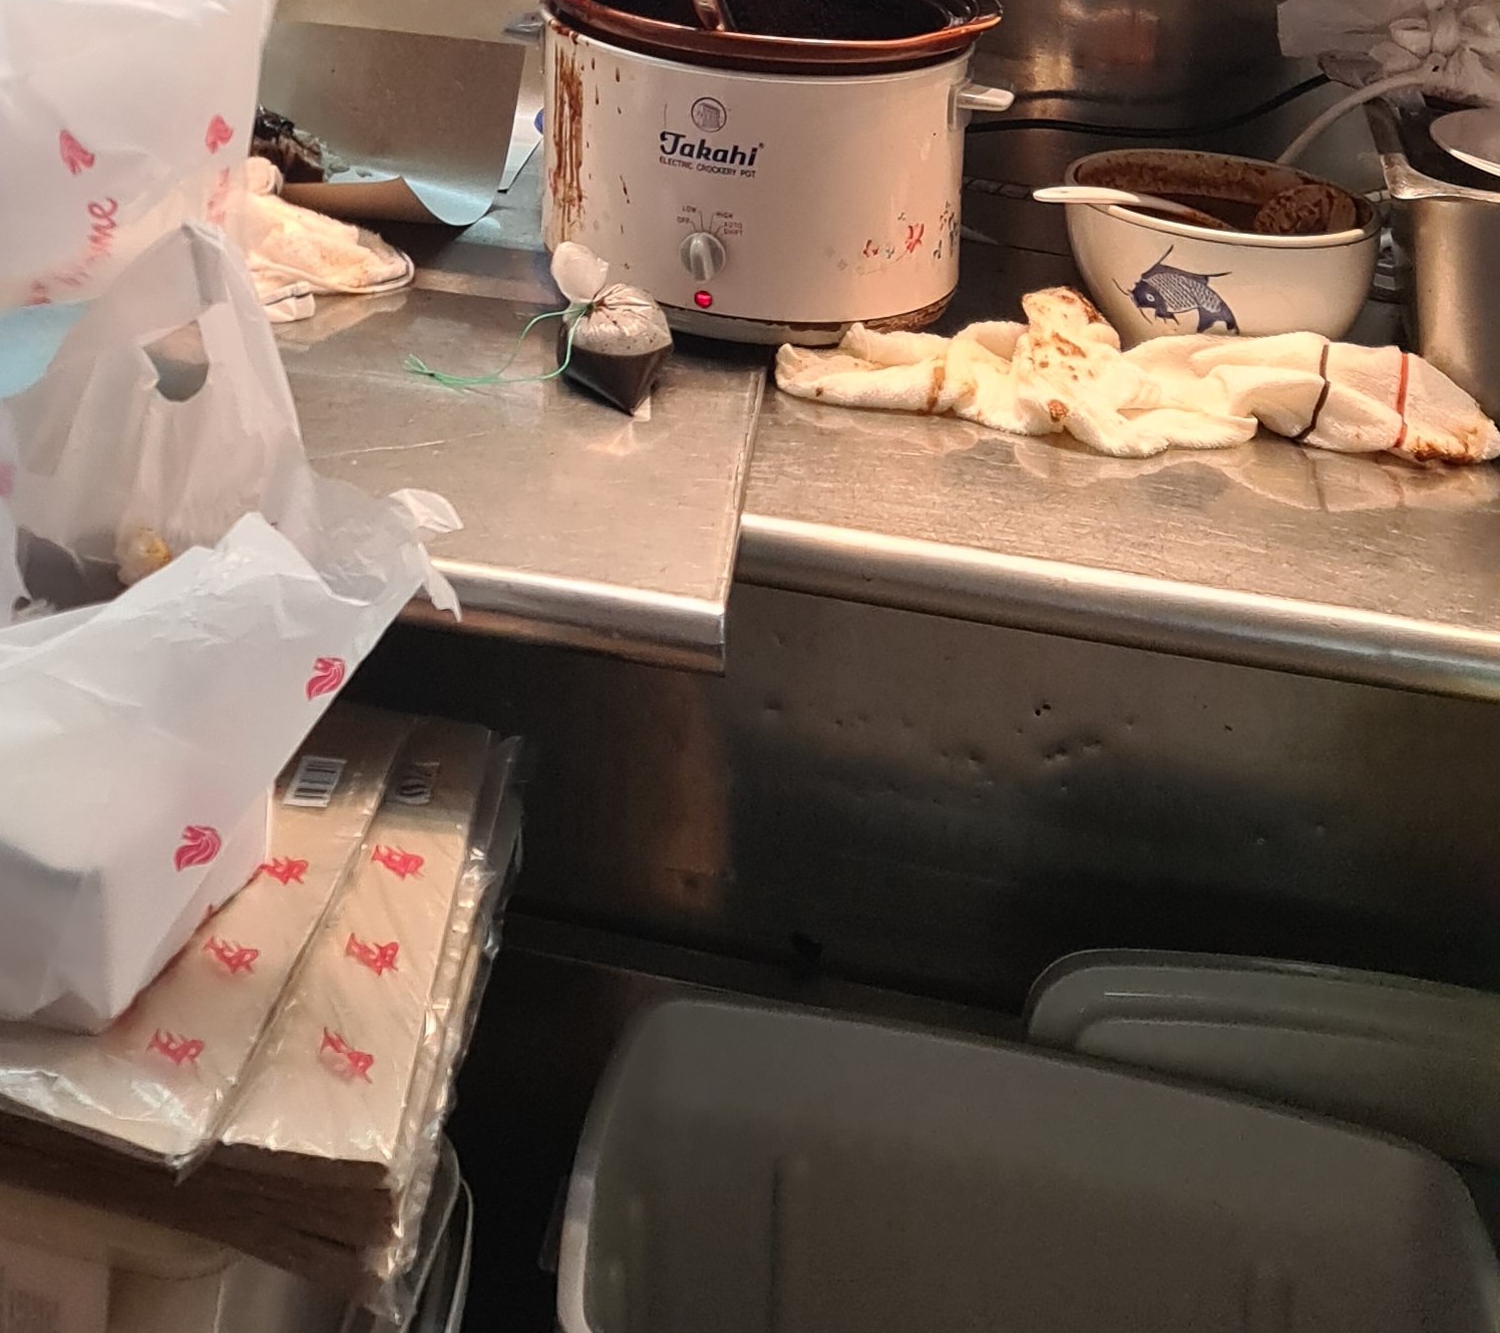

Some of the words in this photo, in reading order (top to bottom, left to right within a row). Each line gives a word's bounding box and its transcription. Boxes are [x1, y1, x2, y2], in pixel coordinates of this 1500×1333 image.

[659, 156, 693, 170] ELECTRIC
[696, 164, 736, 176] CROCKERY
[740, 170, 756, 178] POT
